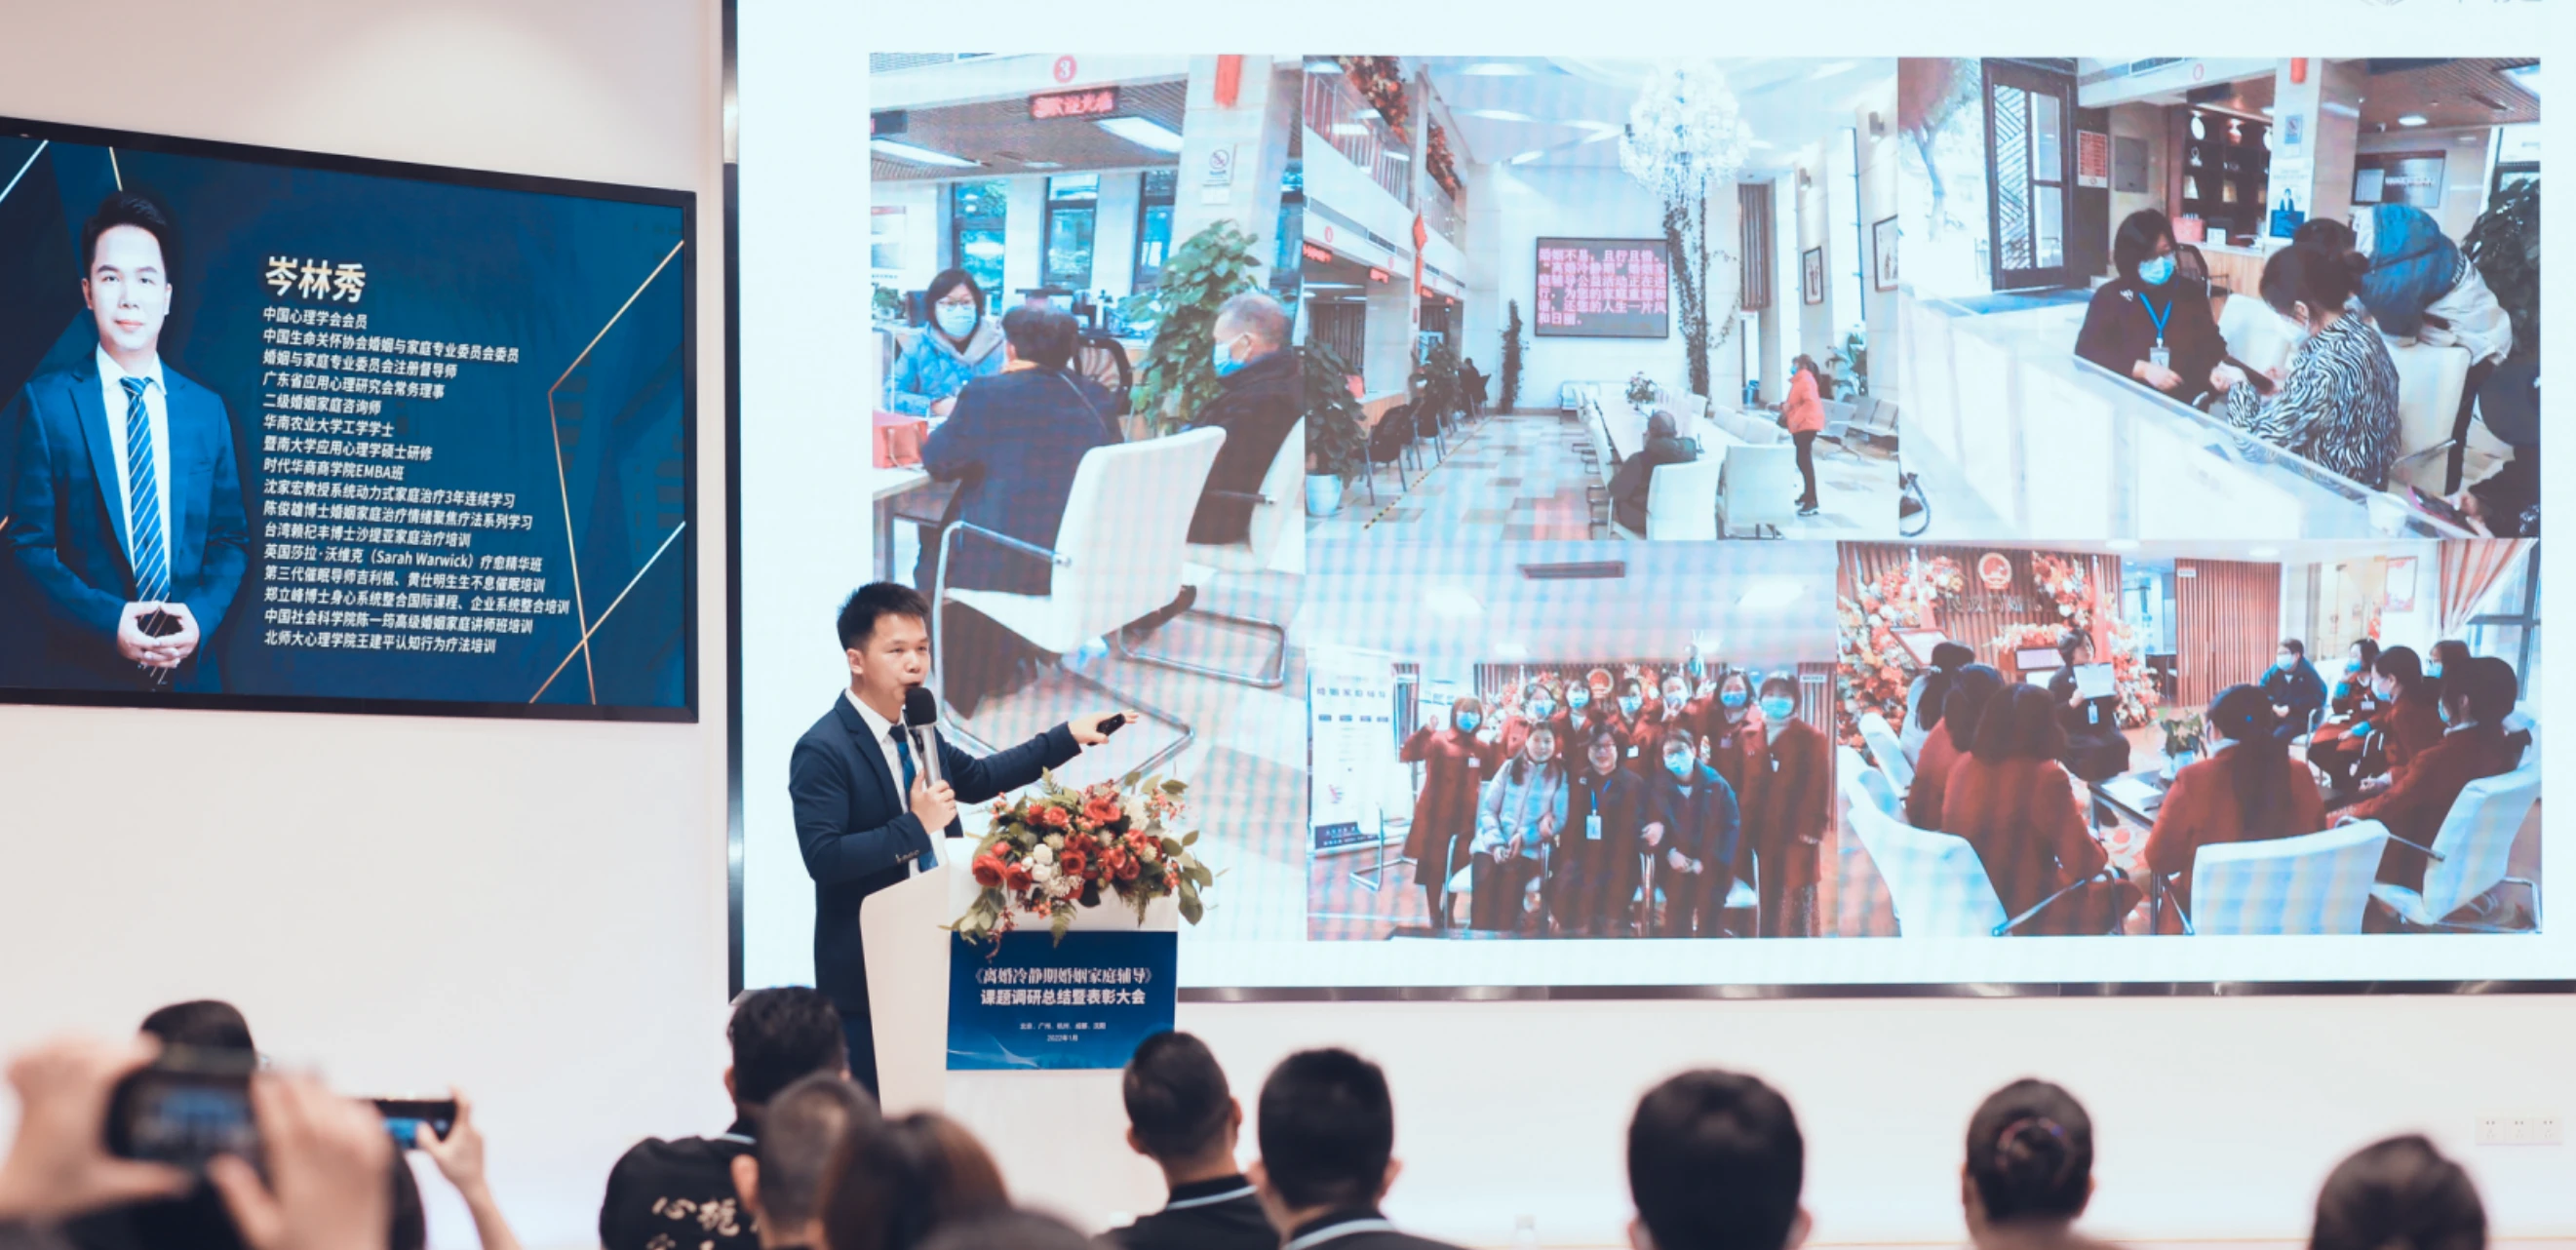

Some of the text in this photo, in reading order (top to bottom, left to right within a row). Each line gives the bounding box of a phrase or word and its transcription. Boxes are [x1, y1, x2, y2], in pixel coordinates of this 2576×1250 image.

[265, 255, 367, 303] 岑林秀
[263, 306, 368, 330] 中国心理学会会员
[263, 328, 519, 363] 中国生命关怀协会婚姻与家庭专业委员会委员
[263, 349, 457, 378] 婚姻与家庭专业委员会注册督导师
[262, 371, 445, 400] 广东省应用心理研究会常务理事
[262, 393, 381, 415] 二级婚姻家庭咨询师
[263, 413, 394, 438] 华南农业大学工学学士
[263, 435, 433, 461] 暨南大学应用心理学硕士研修
[263, 457, 405, 481] 时代华商商学院EMBA班
[263, 479, 516, 509] 沈家宏教授系统动力式家庭治疗3年连续学习
[263, 500, 533, 530] 陈俊雄博士婚姻家庭治疗情绪聚焦疗法系列学习
[264, 522, 471, 548] 台湾赖杞丰博士沙提亚家庭治疗培训
[264, 565, 546, 593] 第三代催眠导师吉利根、黄仕明生生不息催眠培训
[264, 586, 570, 614] 郑立峰博士身心系统整合国际课程、企业系统整合培训
[264, 629, 496, 653] 北师大心理学院王建平认知行为疗法培训
[975, 967, 1152, 985] 《离婚冷静期婚姻家庭辅导》
[981, 989, 1146, 1005] 课题调研总结暨表彰大会
[1047, 1034, 1078, 1042] 2022年1月
